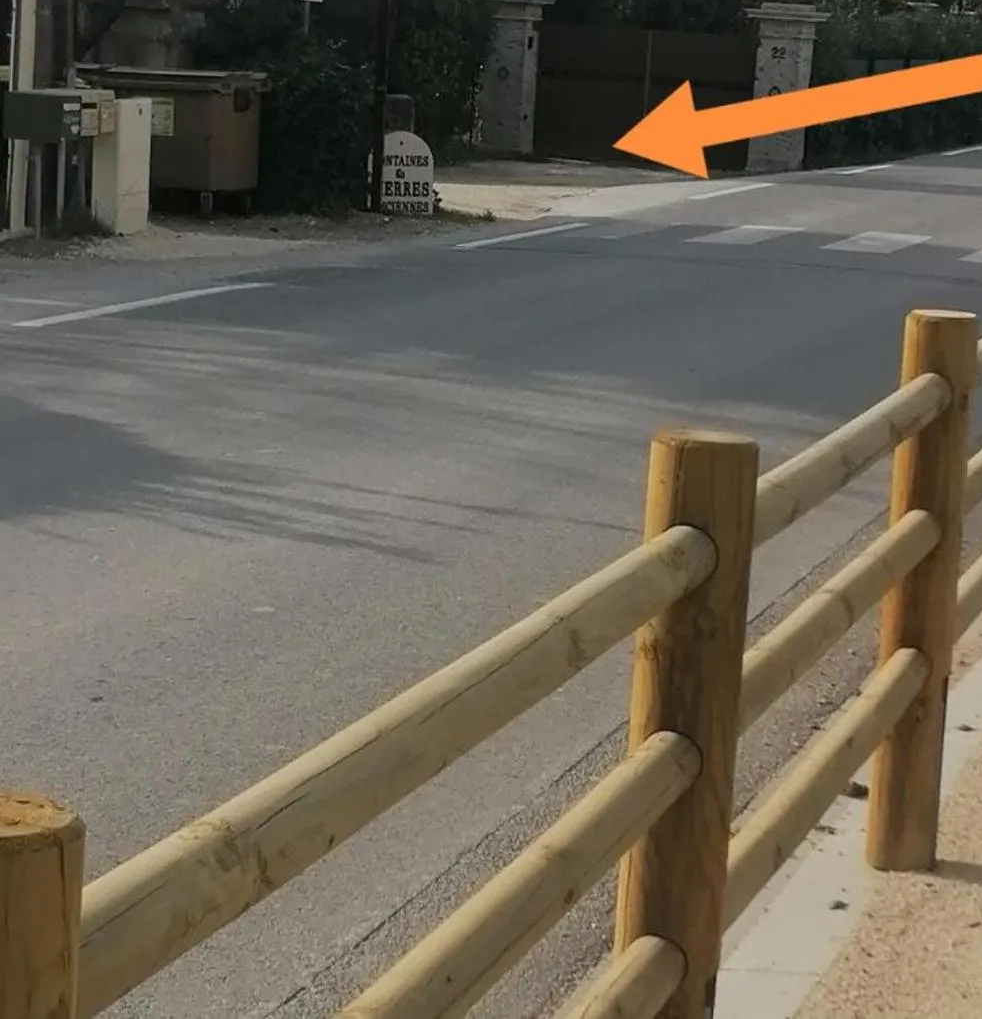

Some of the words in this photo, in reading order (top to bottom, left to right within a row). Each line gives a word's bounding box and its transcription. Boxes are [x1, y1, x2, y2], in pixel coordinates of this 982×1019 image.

[770, 46, 787, 60] 22
[383, 154, 429, 167] NTAINES
[395, 168, 406, 179] &
[384, 181, 430, 197] ERRES
